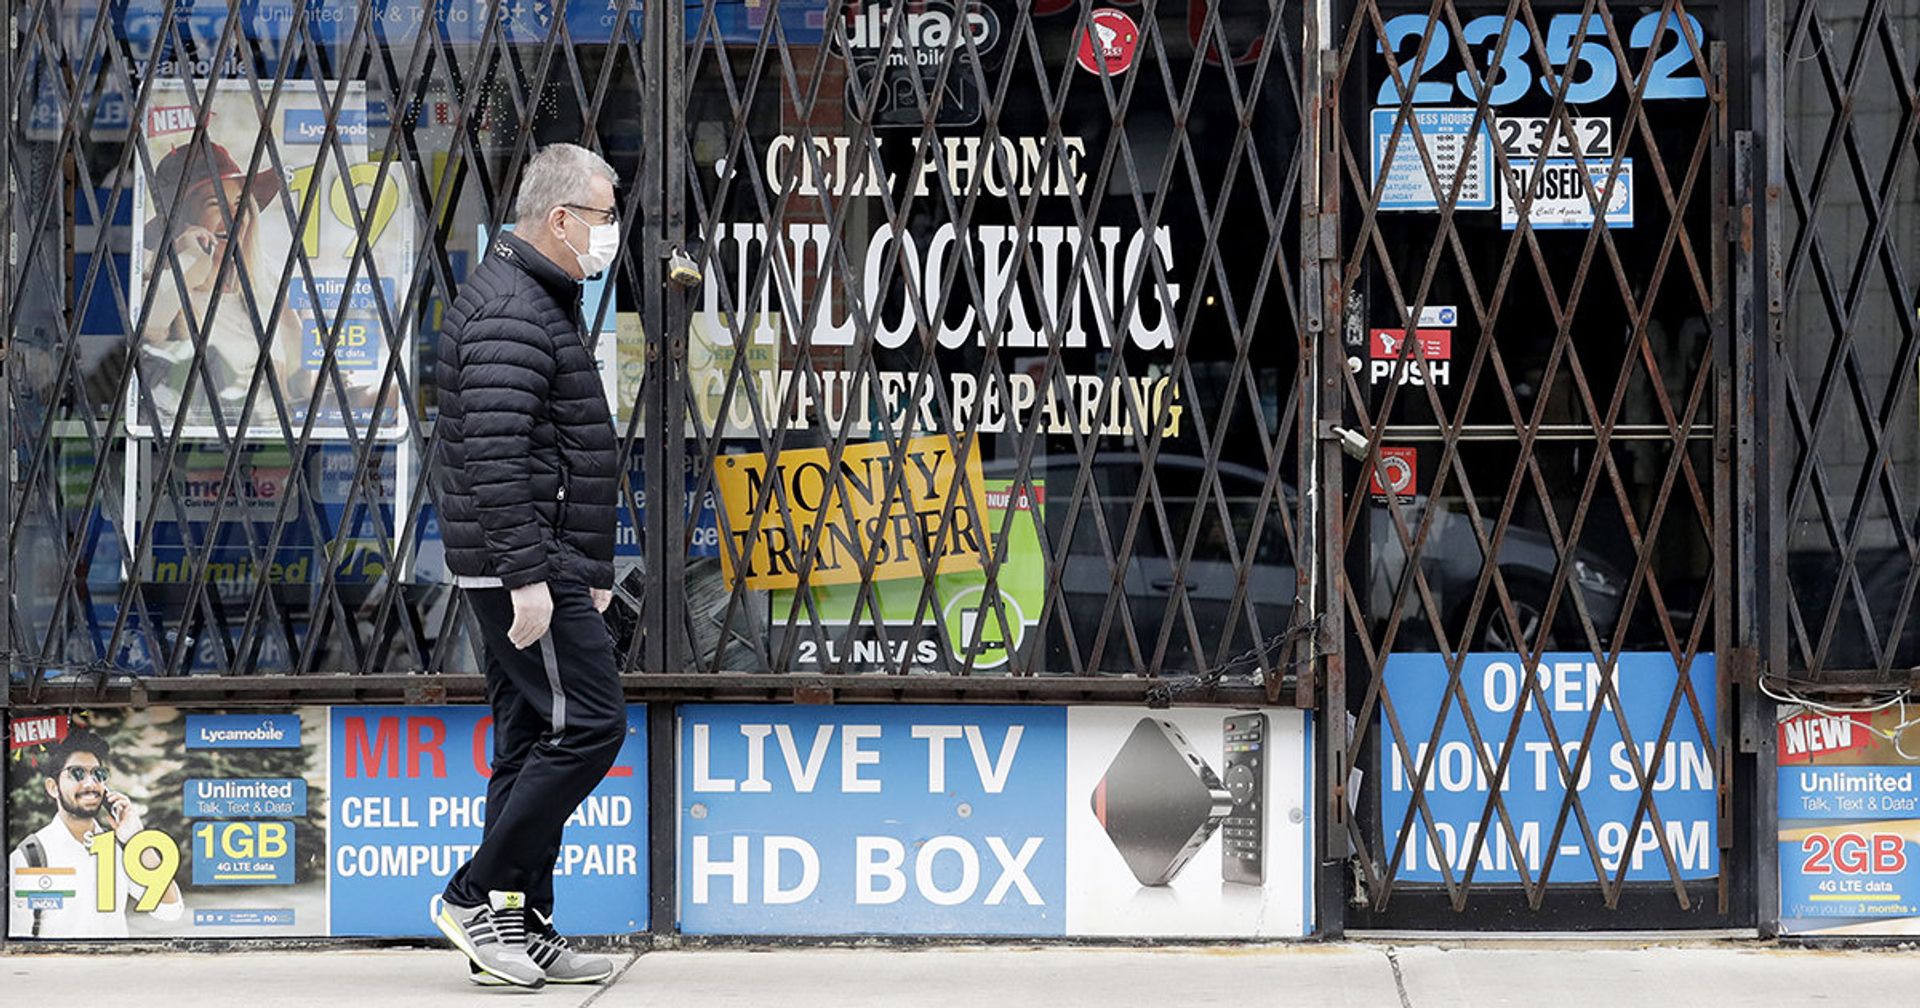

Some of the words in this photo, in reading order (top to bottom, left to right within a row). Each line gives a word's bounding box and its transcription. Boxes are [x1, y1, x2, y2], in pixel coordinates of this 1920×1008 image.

[353, 6, 385, 22] Tlk
[450, 7, 468, 22] to
[1376, 11, 1707, 106] 2352
[1497, 119, 1610, 154] 2352
[765, 134, 897, 197] CELL
[911, 136, 1087, 197] PHONE
[302, 280, 383, 295] Unlimite
[700, 222, 1182, 351] UNLOCKING
[1371, 361, 1450, 386] PUSH
[701, 369, 938, 432] COMPUTER
[951, 373, 1183, 438] REPAIRING
[744, 449, 947, 516] MONEY
[733, 505, 980, 578] TRANSFER
[798, 640, 817, 663] 2
[826, 640, 938, 663] LNEAS
[1482, 661, 1620, 712] OPEN
[13, 717, 57, 743] NEW
[201, 728, 286, 742] Lycamobile
[344, 715, 447, 779] MR
[1785, 715, 1851, 754] NEW
[693, 723, 882, 793] LIVE
[910, 724, 1025, 793] TV
[1390, 741, 1511, 792] MON
[1524, 741, 1592, 792] TO
[1608, 740, 1714, 792] SUN
[197, 781, 292, 799] Unlimited
[1800, 772, 1913, 793] Unlimited
[227, 800, 250, 813] Text
[253, 800, 262, 813] &
[340, 796, 419, 828] CELL
[428, 796, 487, 828] PHO
[1836, 796, 1864, 811] Text
[1867, 796, 1878, 811] &
[197, 822, 289, 859] 1GB
[1395, 821, 1540, 871] 10AM
[1597, 820, 1710, 872] 9PM
[1801, 832, 1909, 876] 2GB
[216, 862, 231, 872] 4G
[233, 862, 251, 872] LTE
[253, 862, 275, 872] data
[336, 844, 480, 877] COMPUT
[692, 835, 821, 904] HD
[855, 835, 1046, 906] BOX
[1818, 881, 1837, 892] 4G
[1840, 881, 1862, 892] LTE
[1865, 880, 1893, 892] data
[1867, 903, 1908, 914] months
